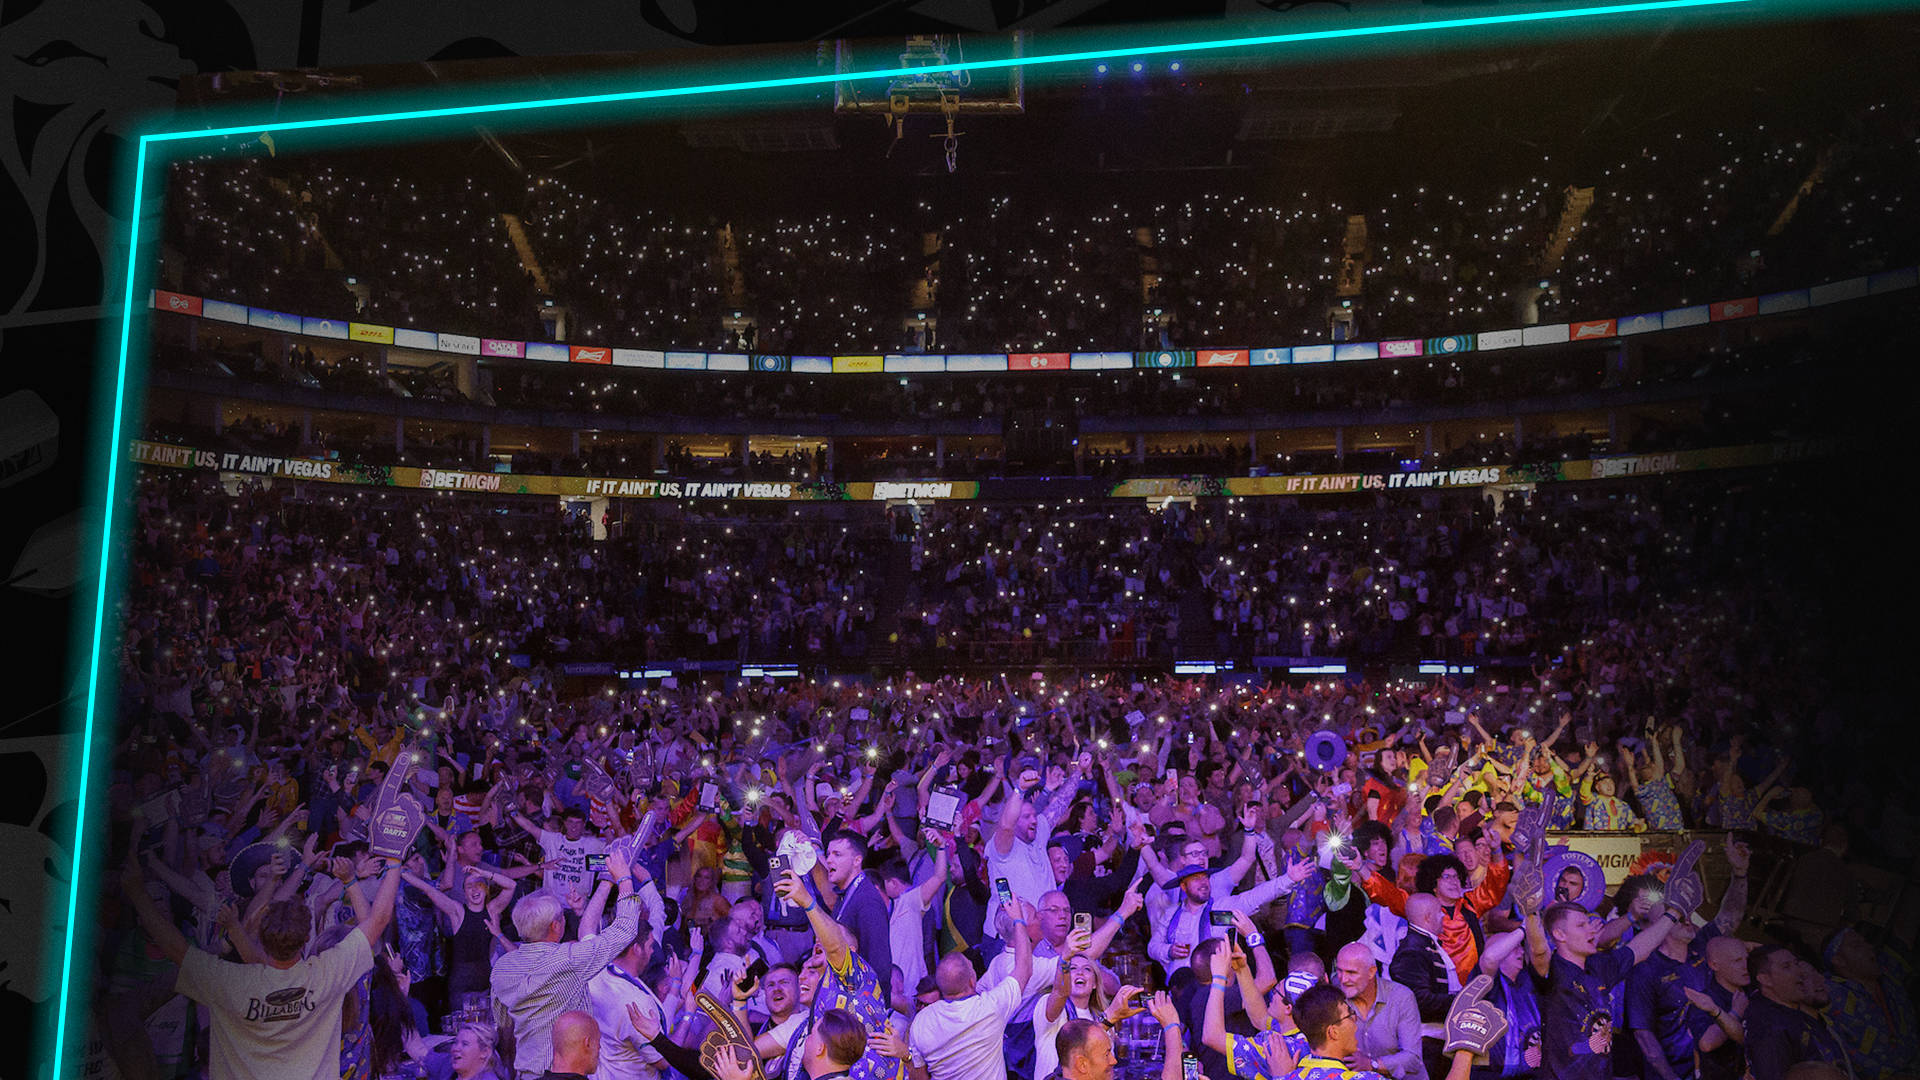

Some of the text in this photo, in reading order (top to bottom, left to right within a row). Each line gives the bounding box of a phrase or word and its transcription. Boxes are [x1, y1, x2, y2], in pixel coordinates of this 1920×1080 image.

[136, 443, 151, 459] IT
[152, 445, 193, 465] AIN'T
[194, 450, 219, 470] US,
[222, 453, 240, 470] IT
[239, 455, 283, 474] AIN'T
[284, 459, 331, 478] VEGAS
[1605, 455, 1677, 475] BETMGM
[434, 472, 500, 490] BETMGM
[1286, 468, 1500, 491] IF IT AIN'T US, IT AIN'T VEGAS
[586, 480, 791, 499] IF IT AIN'T US, IT AIN'T VEGAS
[384, 827, 408, 838] DARTS
[1597, 854, 1636, 868] MGM
[721, 1019, 737, 1039] DARTS
[1460, 1022, 1488, 1035] DARTS
